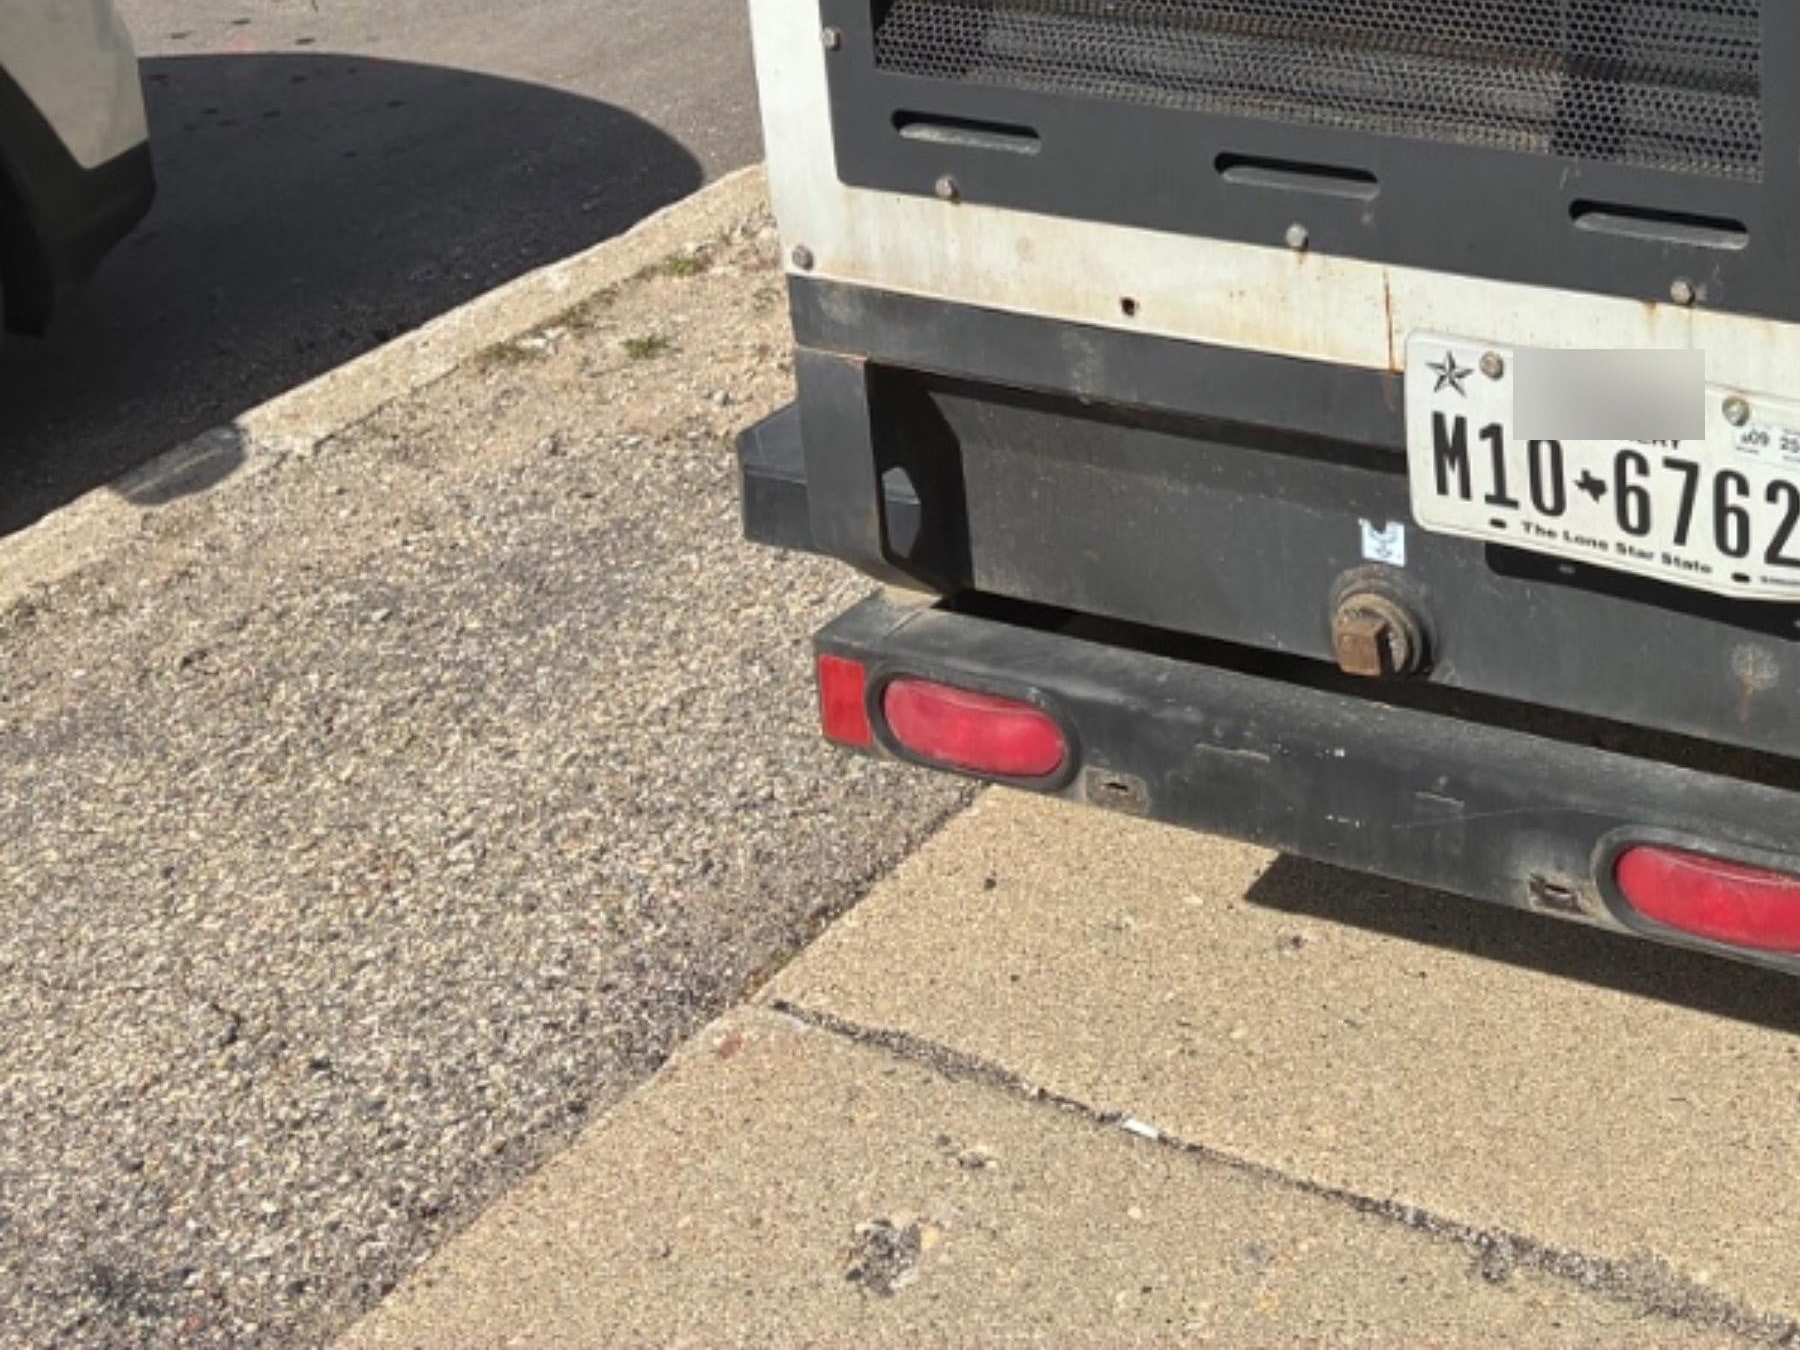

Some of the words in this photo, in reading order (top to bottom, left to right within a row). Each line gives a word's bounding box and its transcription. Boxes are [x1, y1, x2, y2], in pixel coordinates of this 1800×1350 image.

[1431, 410, 1567, 517] M10
[1521, 519, 1558, 539] The
[1562, 529, 1609, 552] Lone
[1615, 541, 1654, 561] Star
[1661, 552, 1713, 575] State
